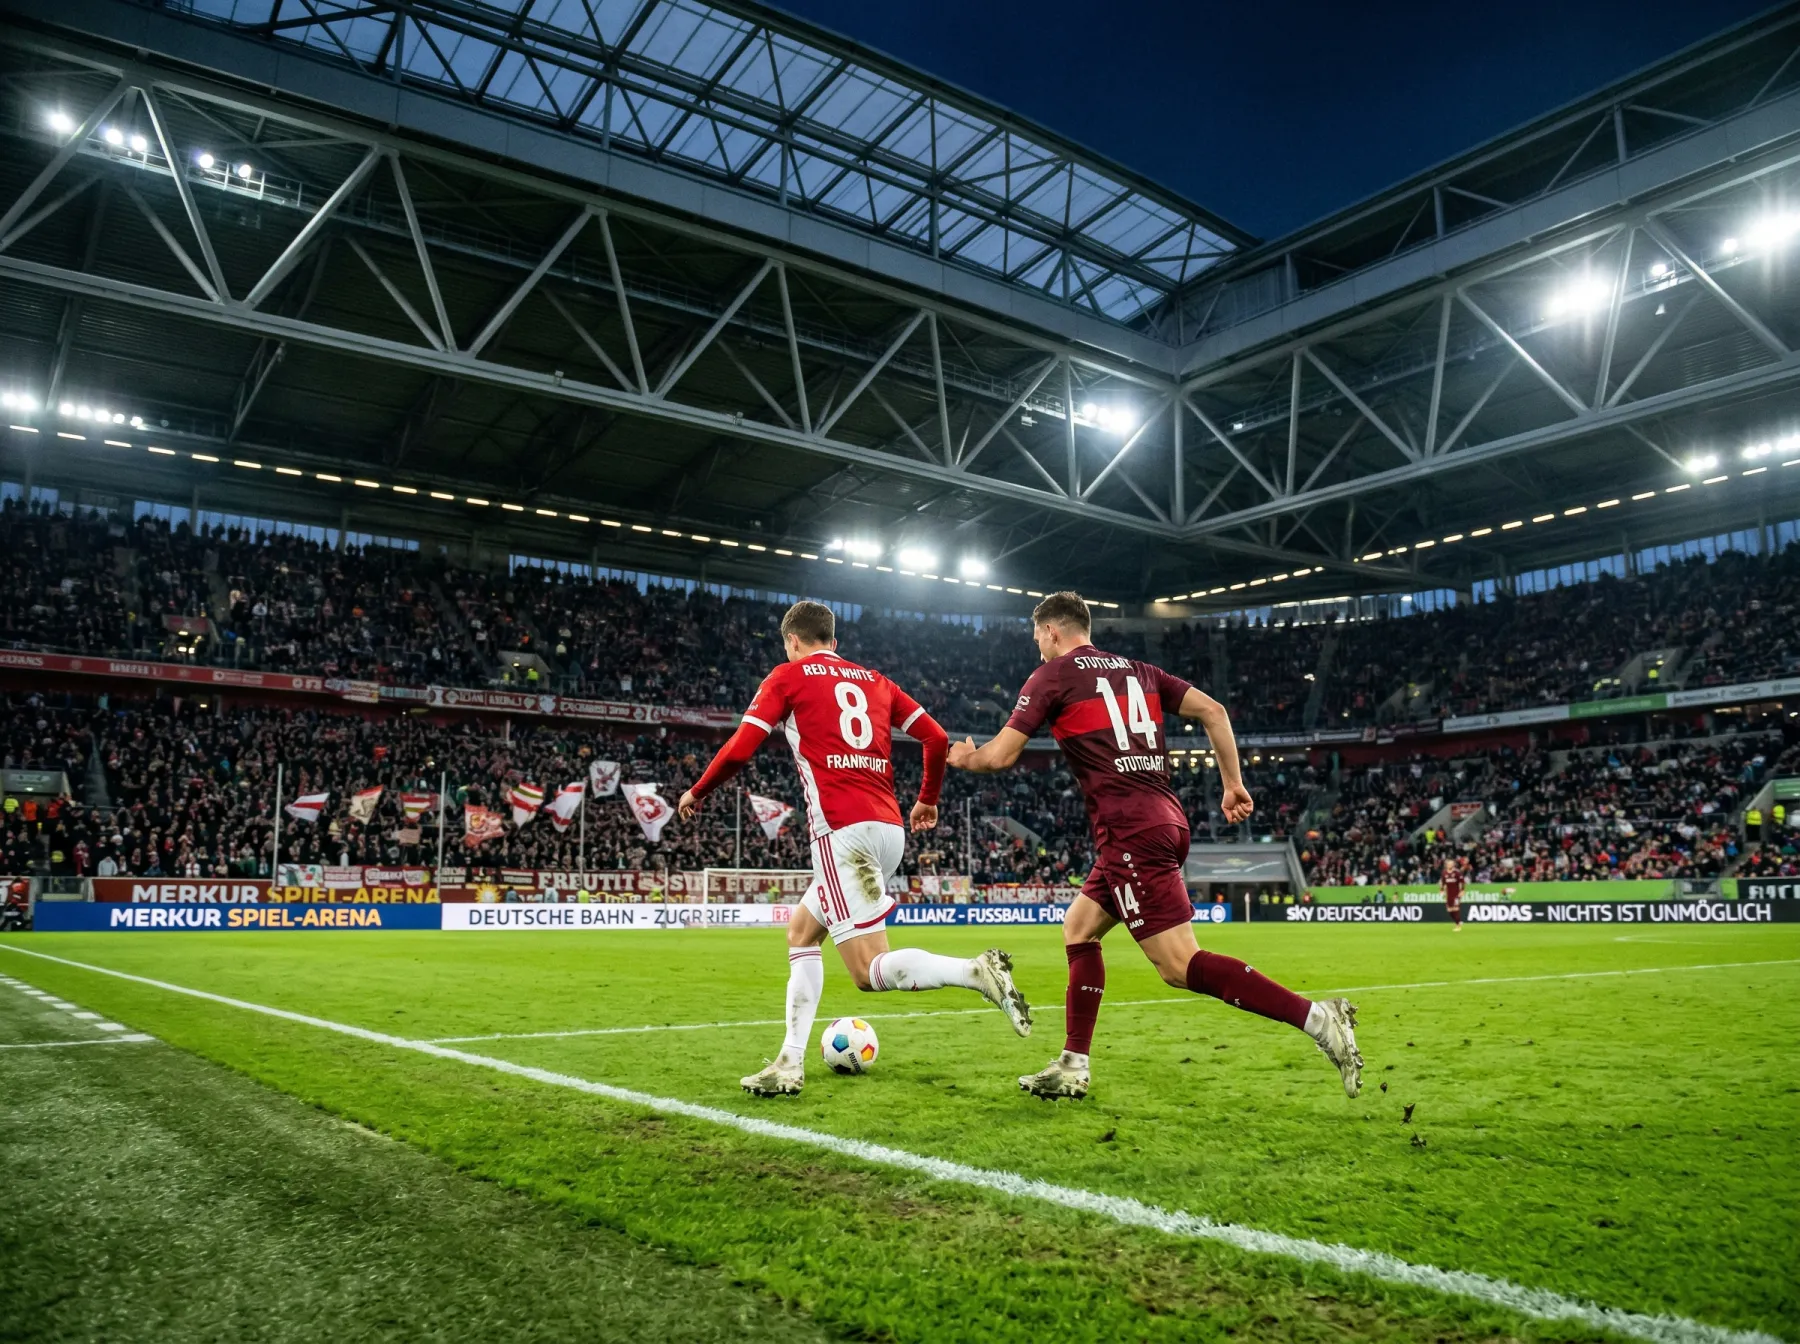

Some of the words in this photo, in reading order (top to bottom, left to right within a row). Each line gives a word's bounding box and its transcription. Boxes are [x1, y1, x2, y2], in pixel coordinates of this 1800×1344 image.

[802, 664, 827, 676] RED
[829, 665, 839, 677] &
[838, 667, 875, 682] WHITE
[834, 681, 873, 750] 8
[1096, 675, 1158, 751] 14
[1114, 755, 1164, 773] STUTTGART
[132, 885, 259, 904] MERKUR
[266, 887, 441, 904] SPIEL-ARENA
[817, 885, 829, 914] 8
[1114, 882, 1140, 919] 14
[110, 908, 221, 927] MERKUR
[228, 908, 382, 927] SPIEL-ARENA
[469, 909, 574, 925] DEUTSCHE
[581, 909, 634, 925] BAHN
[895, 908, 956, 923] ALLIANZ
[967, 908, 1037, 923] FUSSBALL
[1039, 904, 1065, 922] FÜR
[1317, 906, 1423, 921] DEUTSCHLAND
[1467, 905, 1532, 921] ADIDAS
[1547, 904, 1612, 922] NICHTS
[1617, 904, 1645, 921] IST
[1650, 900, 1772, 922] UNMÖGLICH
